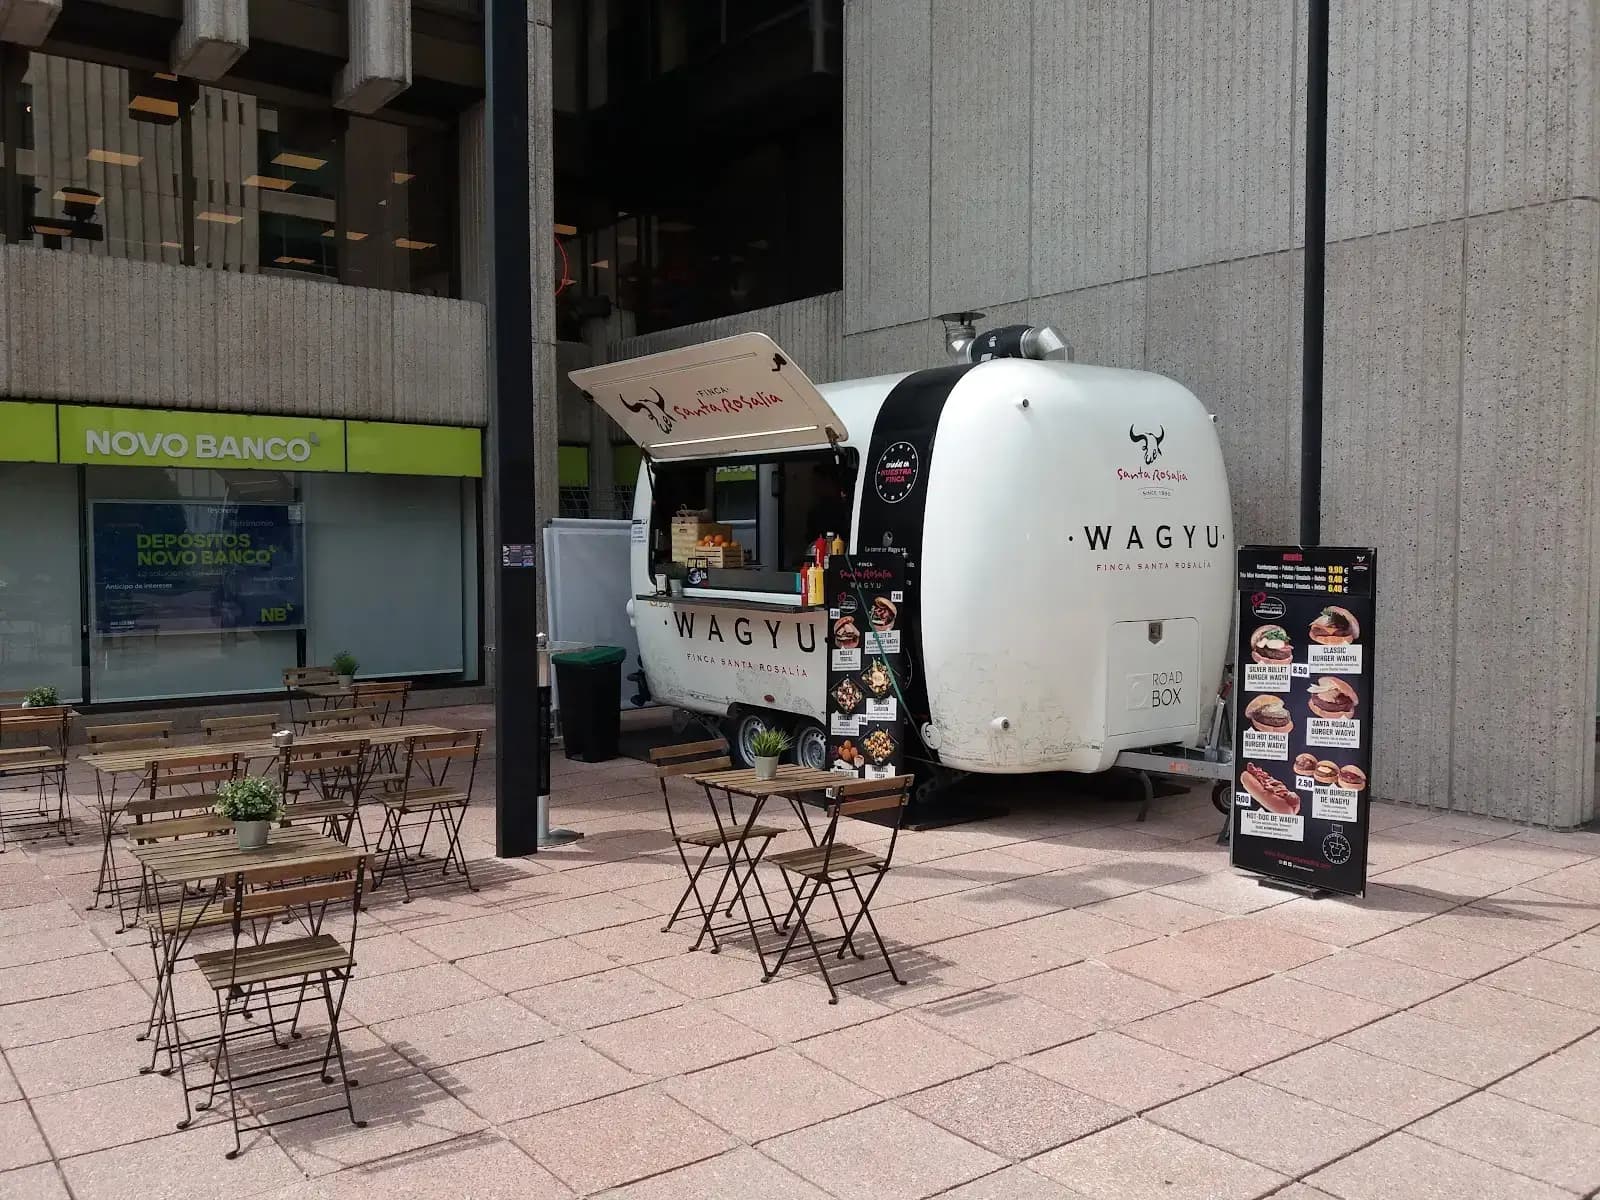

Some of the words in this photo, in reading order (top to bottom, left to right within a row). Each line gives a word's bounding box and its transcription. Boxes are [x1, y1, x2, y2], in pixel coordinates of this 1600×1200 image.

[699, 385, 726, 398] FINCA
[673, 398, 719, 421] Santa
[86, 430, 189, 457] NOVO
[196, 434, 312, 462] BANCO
[1117, 467, 1151, 480] Santa
[1084, 525, 1219, 551] WAGYU
[137, 550, 197, 566] NOVO
[201, 549, 271, 566] BANCO
[1096, 564, 1131, 572] FINCA
[1137, 562, 1169, 570] SANTA
[105, 583, 134, 591] Anticipo
[261, 607, 287, 622] NB
[674, 611, 816, 653] WAGYU
[687, 653, 716, 665] FINCA
[721, 657, 753, 670] SANTA
[1292, 665, 1308, 675] 8.50
[1152, 670, 1183, 686] ROAD
[1247, 673, 1268, 681] BURGER
[1152, 688, 1182, 707] BOX
[1311, 728, 1333, 736] BURGER
[1335, 729, 1356, 737] WAGYU
[1244, 740, 1266, 748] BURGER
[1297, 778, 1313, 788] 2.50
[1320, 796, 1328, 804] DE
[1329, 797, 1350, 806] WAGYU
[1279, 815, 1299, 824] WAGYU
